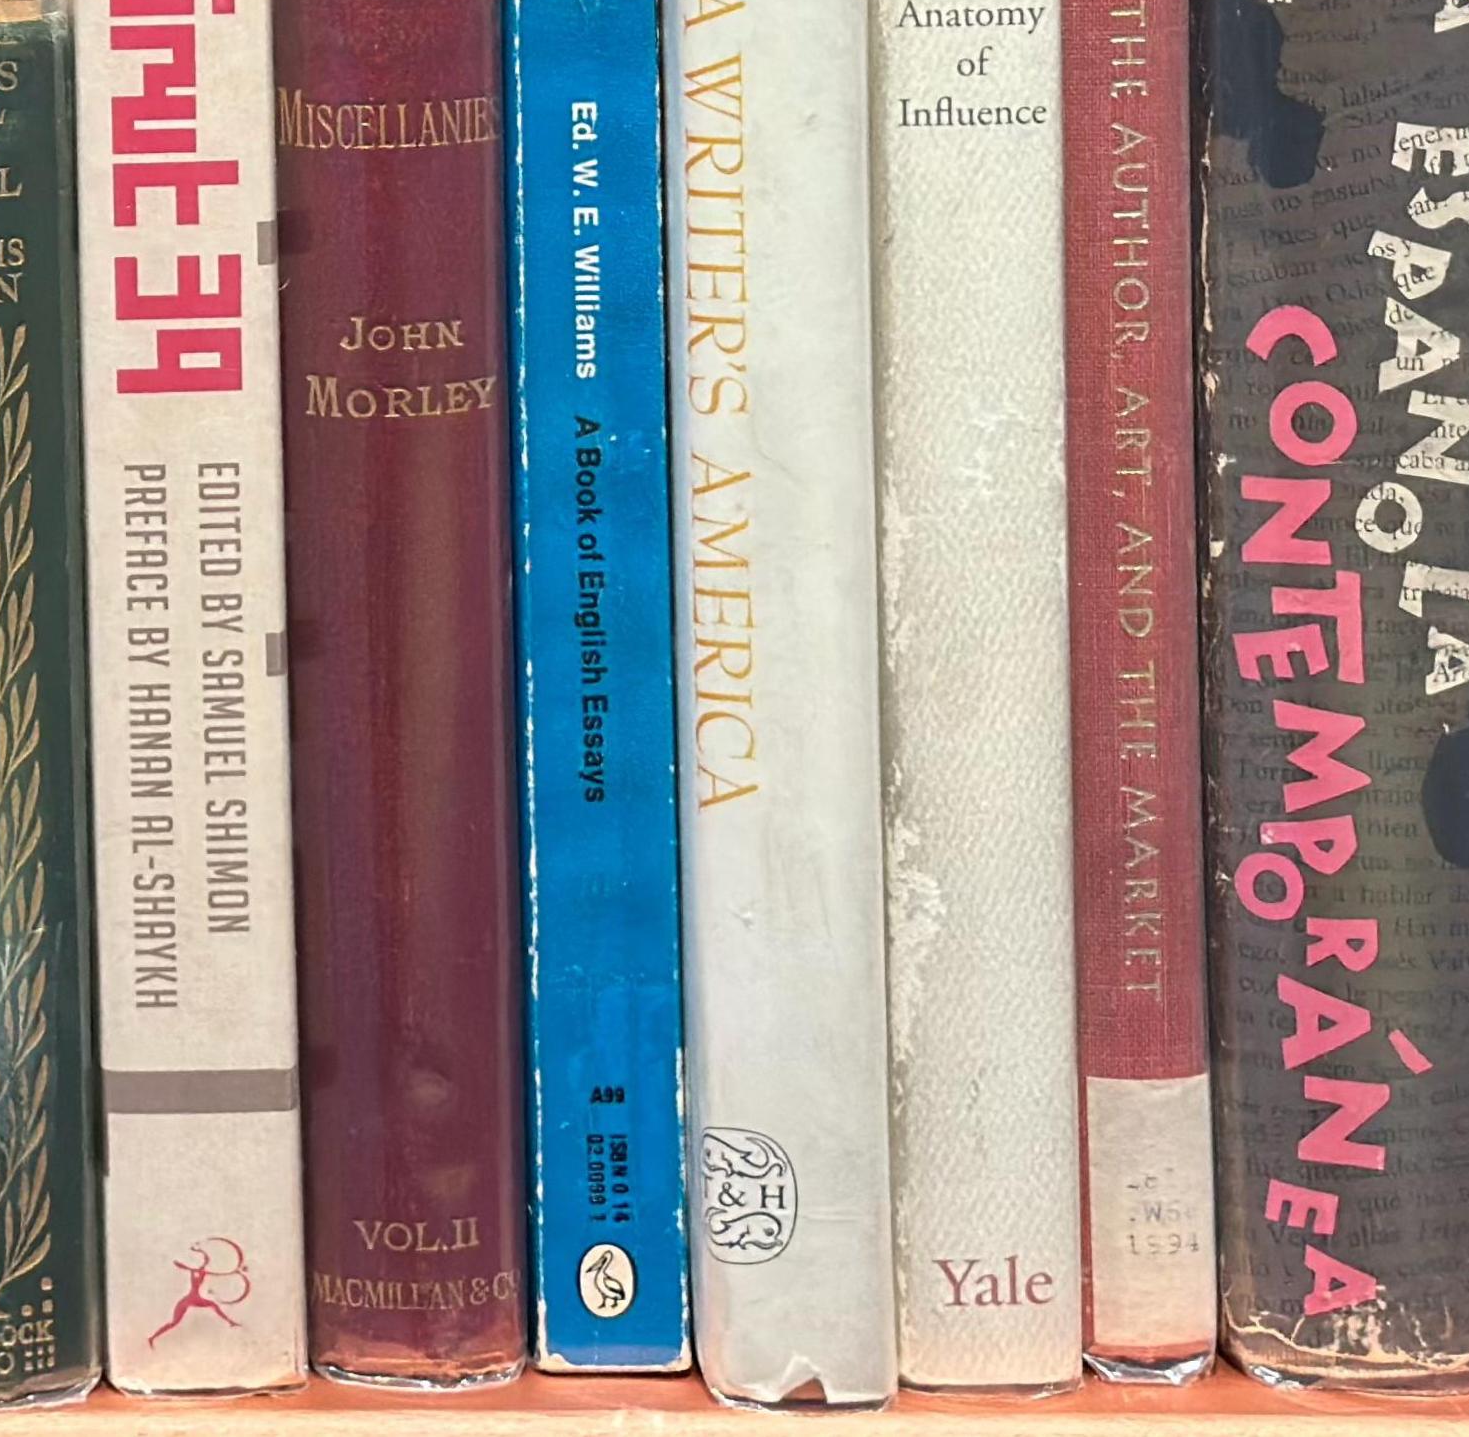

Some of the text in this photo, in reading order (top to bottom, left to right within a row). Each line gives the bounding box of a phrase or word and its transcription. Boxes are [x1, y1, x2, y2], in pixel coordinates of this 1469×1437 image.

[895, 0, 1045, 34] Anatomy
[898, 96, 1047, 127] Influence
[957, 46, 992, 76] of
[114, 254, 243, 394] 39
[571, 101, 601, 379] Ed. W. E. Williams
[684, 52, 750, 415] WRITER'S
[574, 415, 609, 803] A Book of English Essays
[690, 453, 760, 811] AMERICA
[1109, 0, 1161, 1003] THE AUTHOR, ART, AND THE MARKET
[124, 464, 179, 1010] PREFACE BY HANAN AL-SHAYKH
[198, 461, 250, 935] EDITED BY SAMUEL SHIMON
[1234, 305, 1433, 1319] CONTEMPORÁNEA
[469, 1276, 490, 1305] &
[610, 1135, 628, 1179] ISBN
[933, 1254, 1054, 1308] Yale
